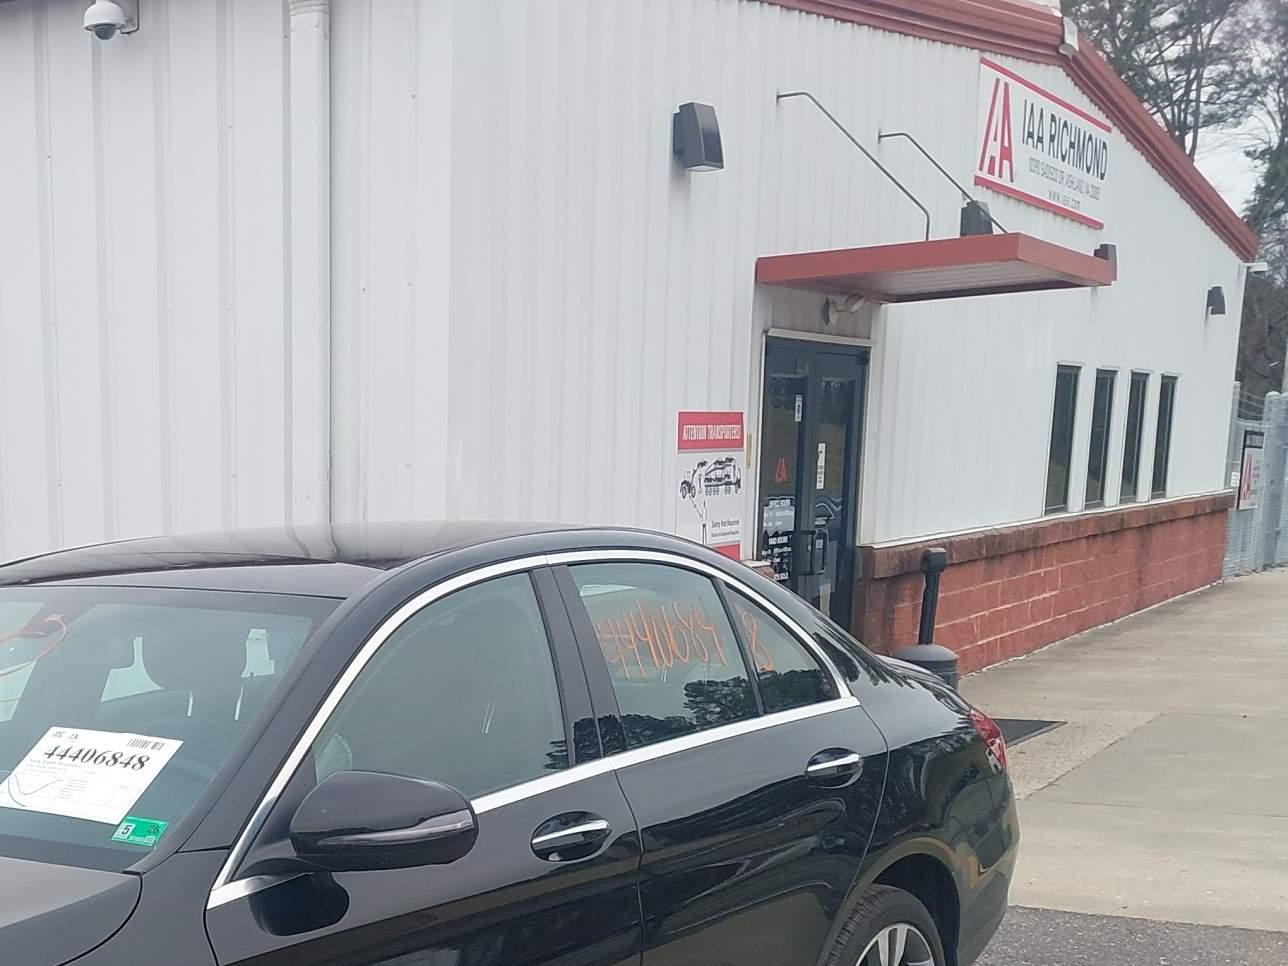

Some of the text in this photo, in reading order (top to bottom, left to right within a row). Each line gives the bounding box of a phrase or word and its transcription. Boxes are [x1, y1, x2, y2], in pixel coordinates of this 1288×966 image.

[1022, 99, 1108, 181] IAA RICHMOND
[682, 424, 707, 441] ATTENTION
[44, 744, 151, 772] 44406848
[121, 824, 161, 835] 5 26
